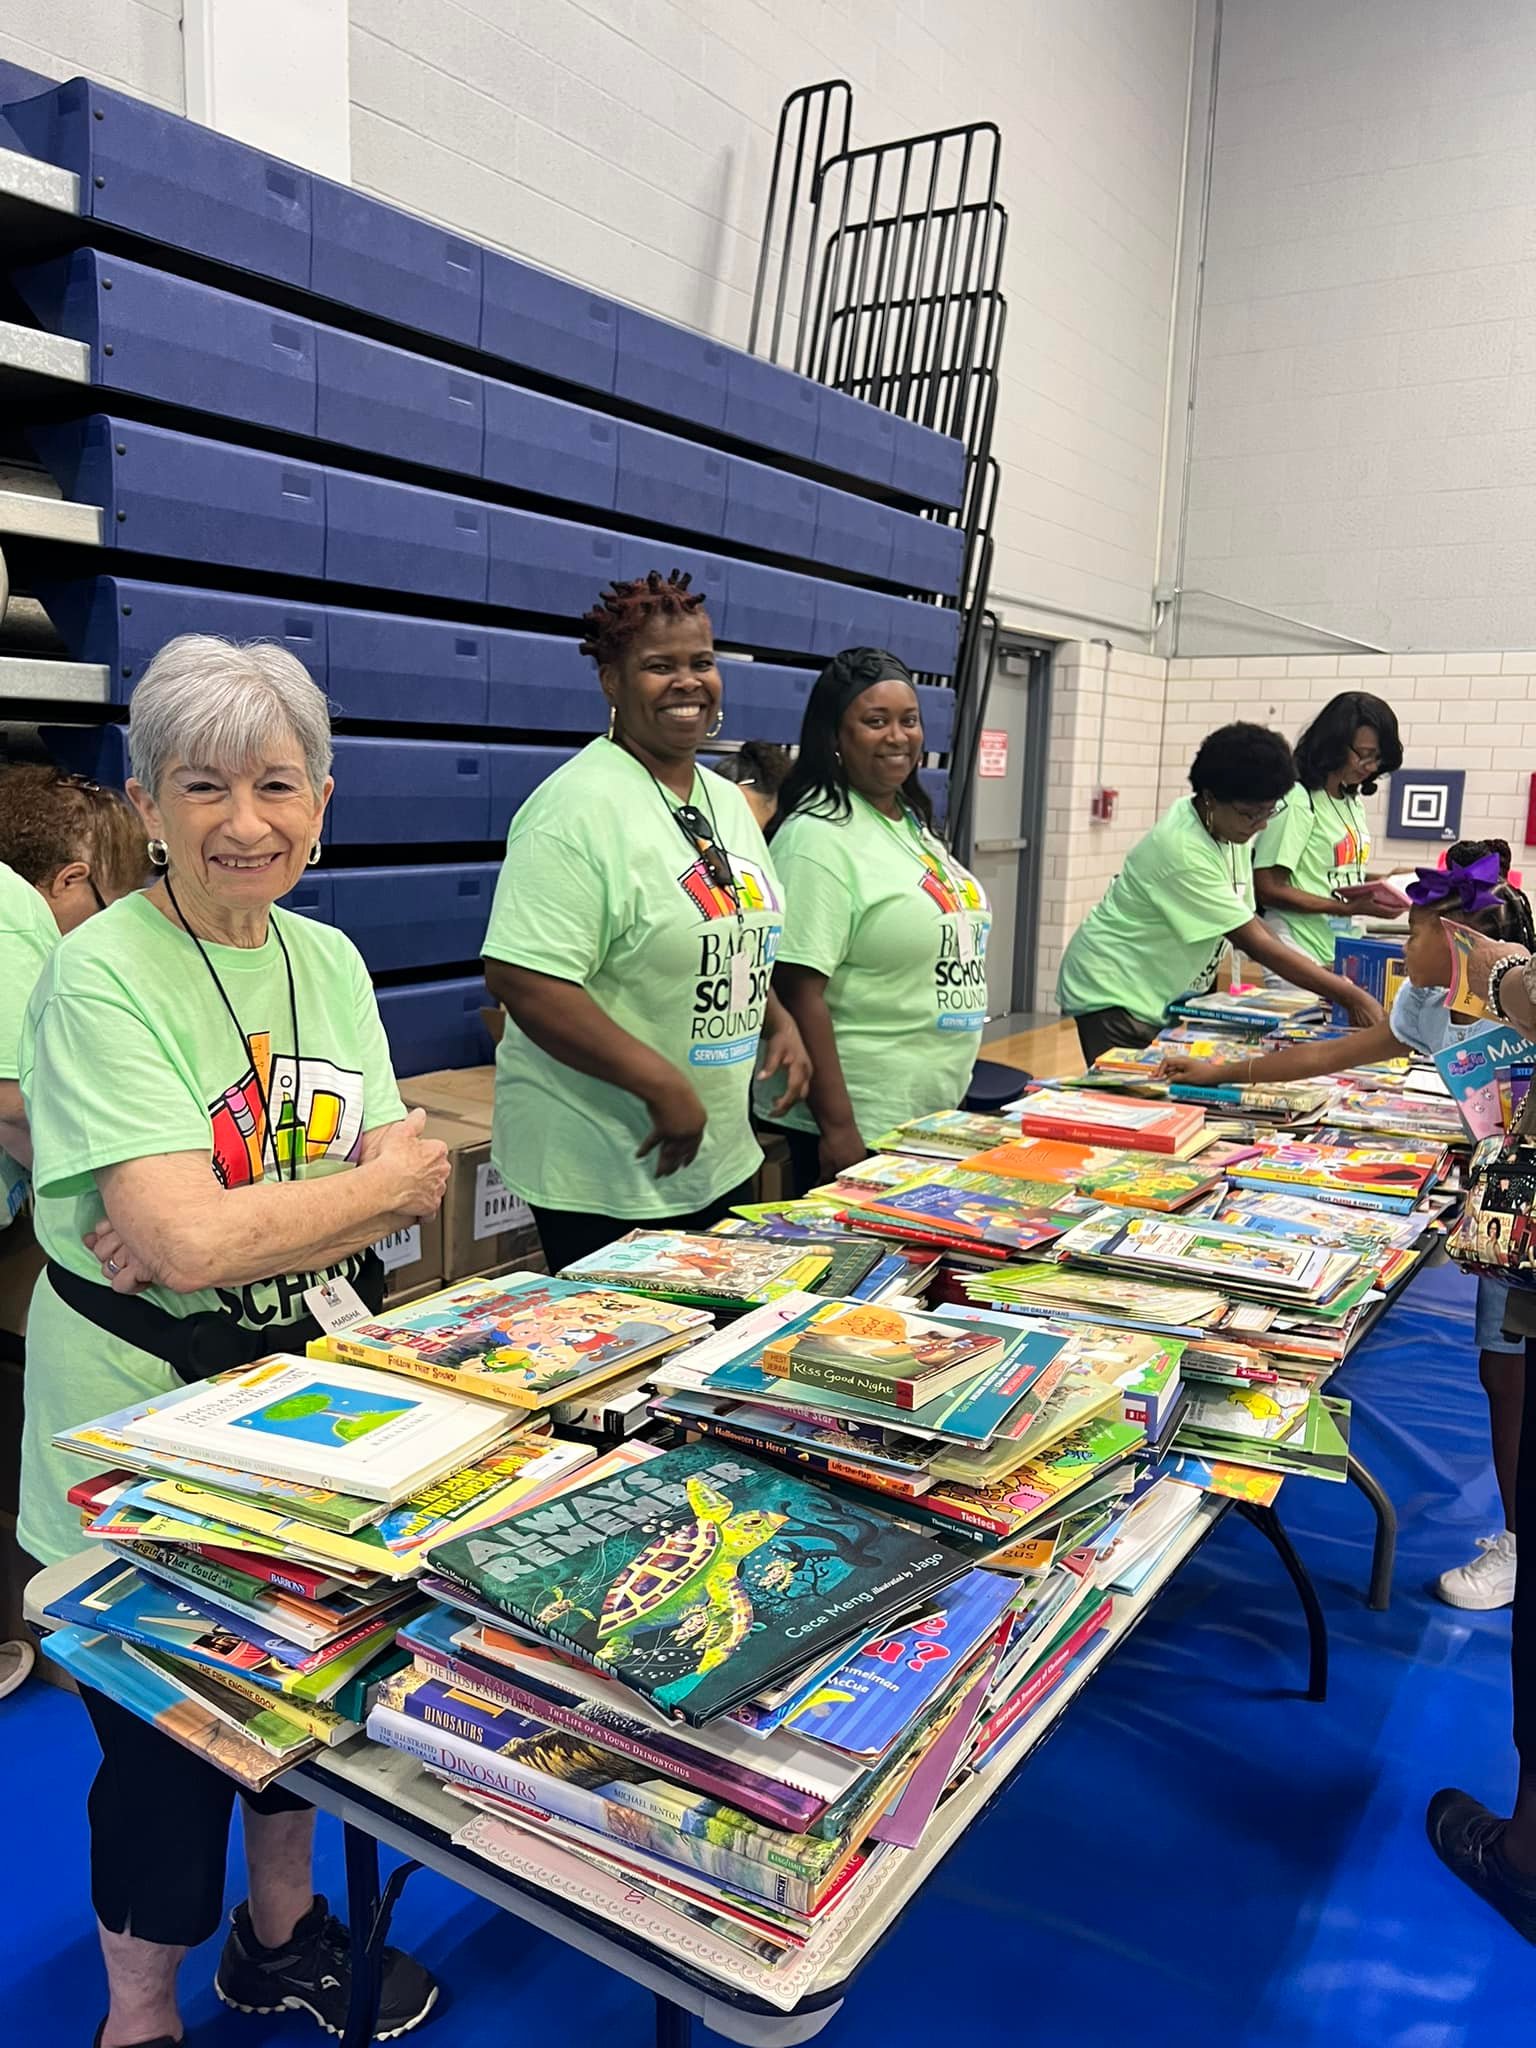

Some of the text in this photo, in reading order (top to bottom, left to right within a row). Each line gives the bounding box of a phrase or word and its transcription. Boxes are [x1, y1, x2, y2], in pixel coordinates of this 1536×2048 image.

[331, 1310, 361, 1328] MARSHA
[791, 1362, 894, 1396] Kiss Good Night
[714, 1426, 754, 1445] Halloween
[466, 1470, 664, 1566] ALWAYS
[480, 1462, 757, 1583] REMEMBER
[960, 1511, 997, 1531] Ticktock
[190, 1559, 220, 1581] Could
[784, 1615, 829, 1640] Cece
[823, 1589, 874, 1619] Meng
[910, 1551, 944, 1573] Jago
[425, 1662, 444, 1678] THE
[253, 1692, 277, 1711] BOOK
[424, 1704, 484, 1743] DINOSAURS
[547, 1706, 564, 1720] THE
[563, 1711, 584, 1730] LIFE
[602, 1731, 631, 1752] YOUNG
[632, 1744, 691, 1778] DEINONYCHUS
[439, 1748, 537, 1800] DINOSAURS
[613, 1787, 682, 1823] MICHAEL BENTON
